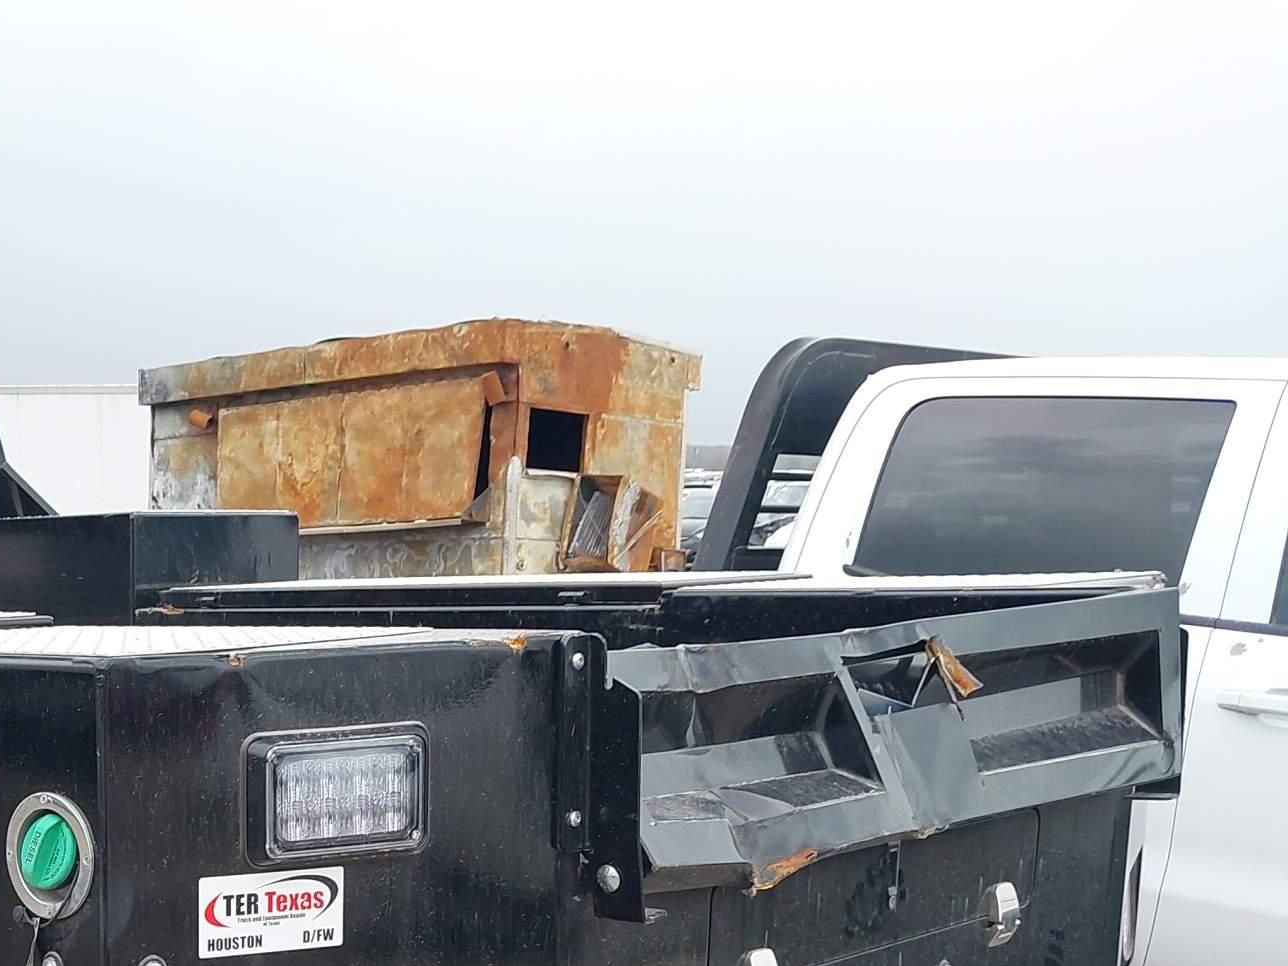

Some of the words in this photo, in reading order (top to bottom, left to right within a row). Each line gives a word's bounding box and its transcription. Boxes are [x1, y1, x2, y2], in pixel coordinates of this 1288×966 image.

[25, 831, 42, 864] DIESEL
[223, 893, 259, 917] TER
[264, 891, 324, 912] Texas
[208, 934, 262, 952] HOUSTON
[303, 928, 334, 943] D/FW
